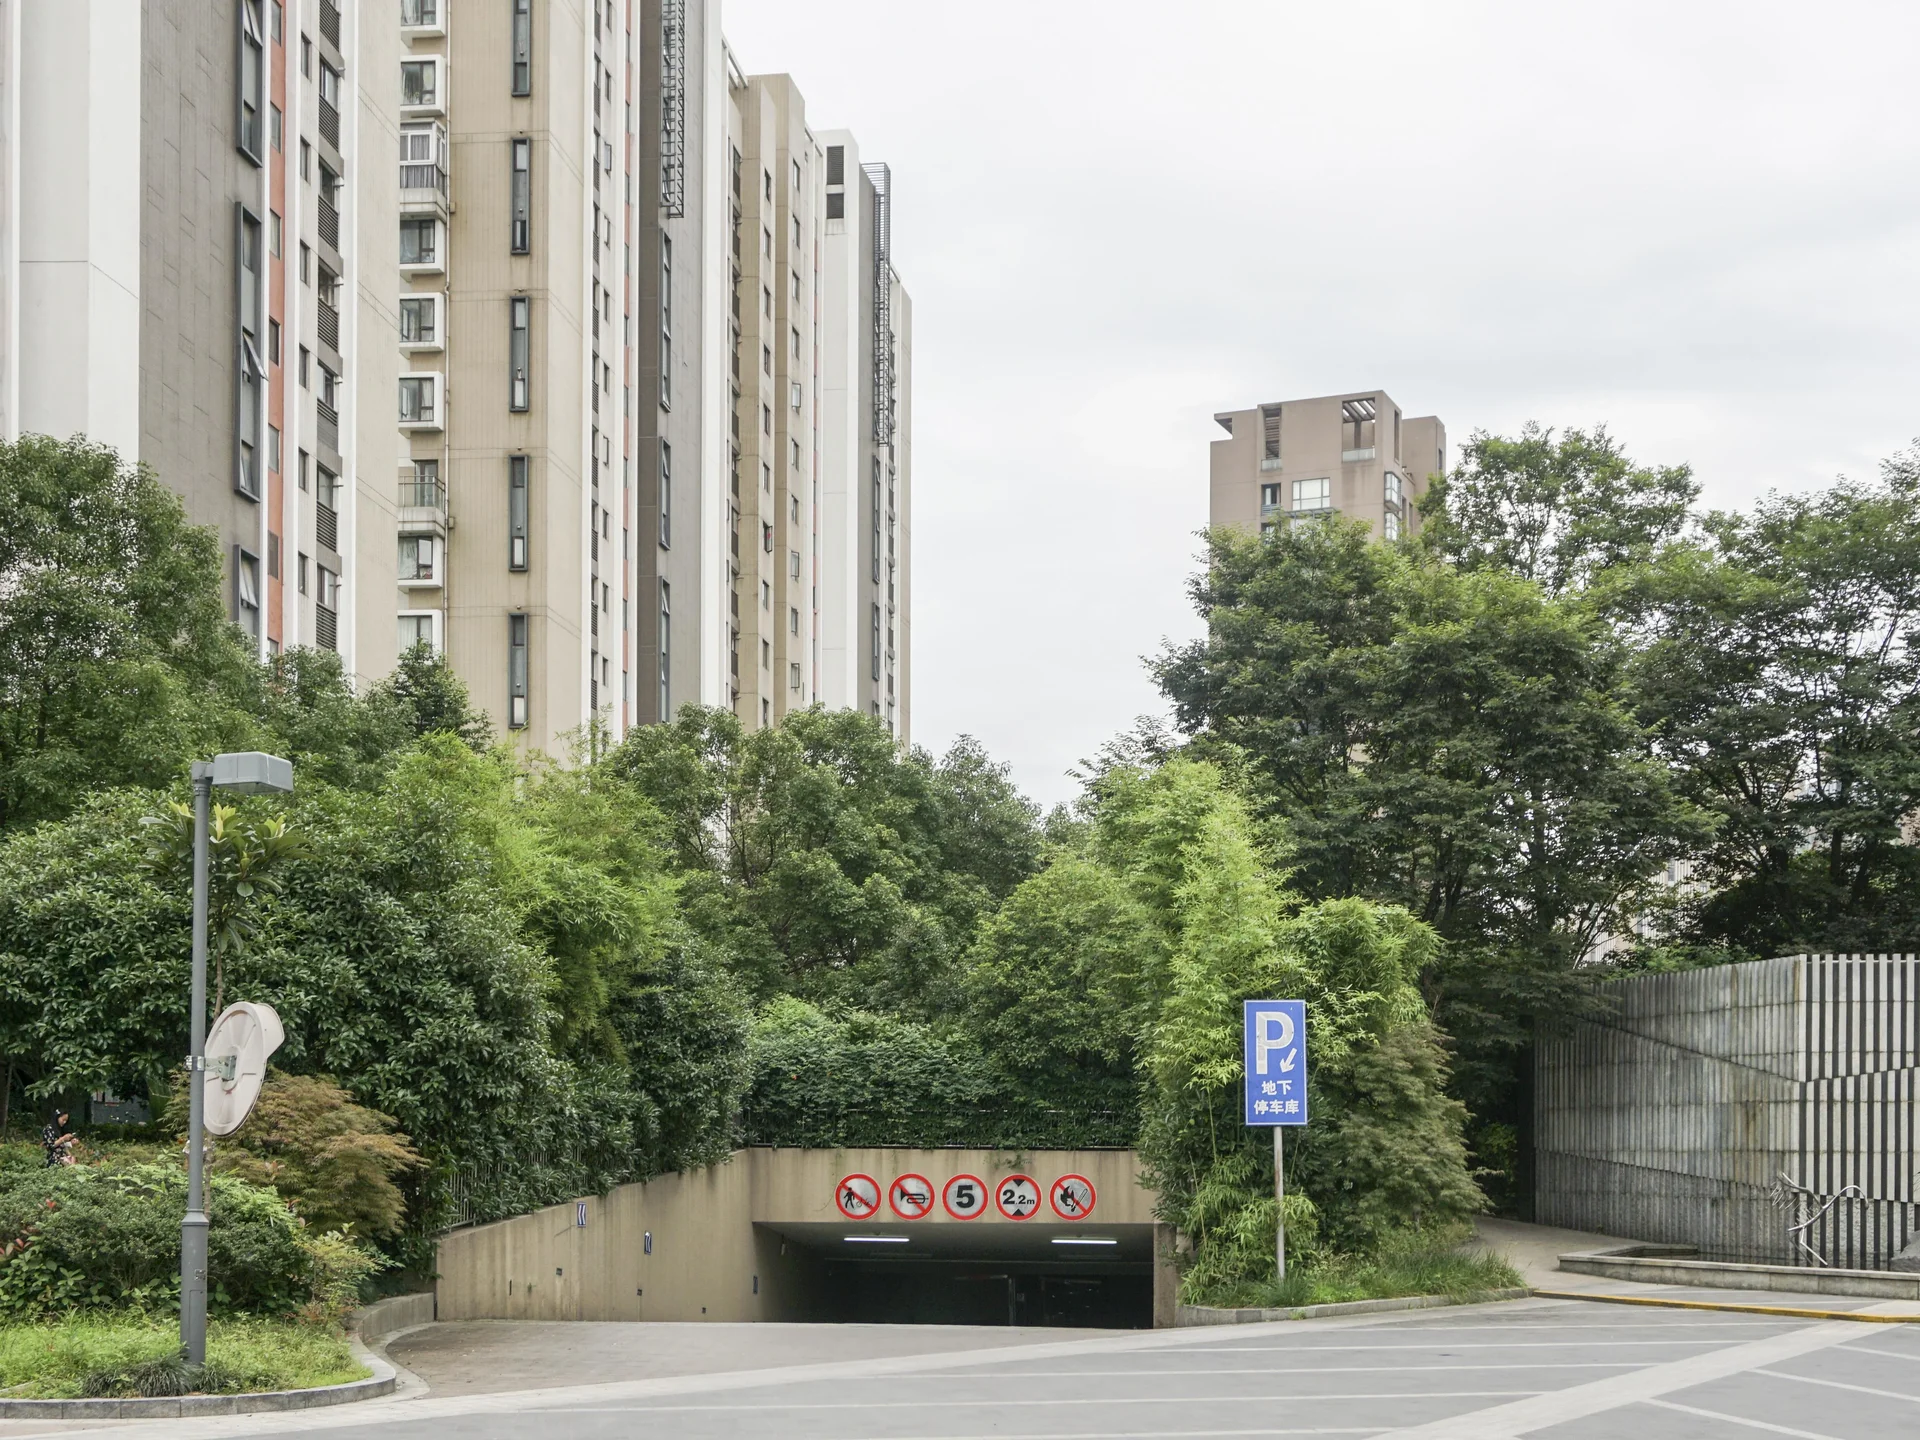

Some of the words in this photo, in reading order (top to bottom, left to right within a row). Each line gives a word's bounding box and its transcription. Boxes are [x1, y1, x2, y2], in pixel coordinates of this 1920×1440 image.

[1256, 1011, 1295, 1075] P
[1261, 1080, 1293, 1096] 地下
[1254, 1099, 1300, 1115] 停车库
[956, 1185, 975, 1208] 5
[1002, 1189, 1035, 1205] 2.2m
